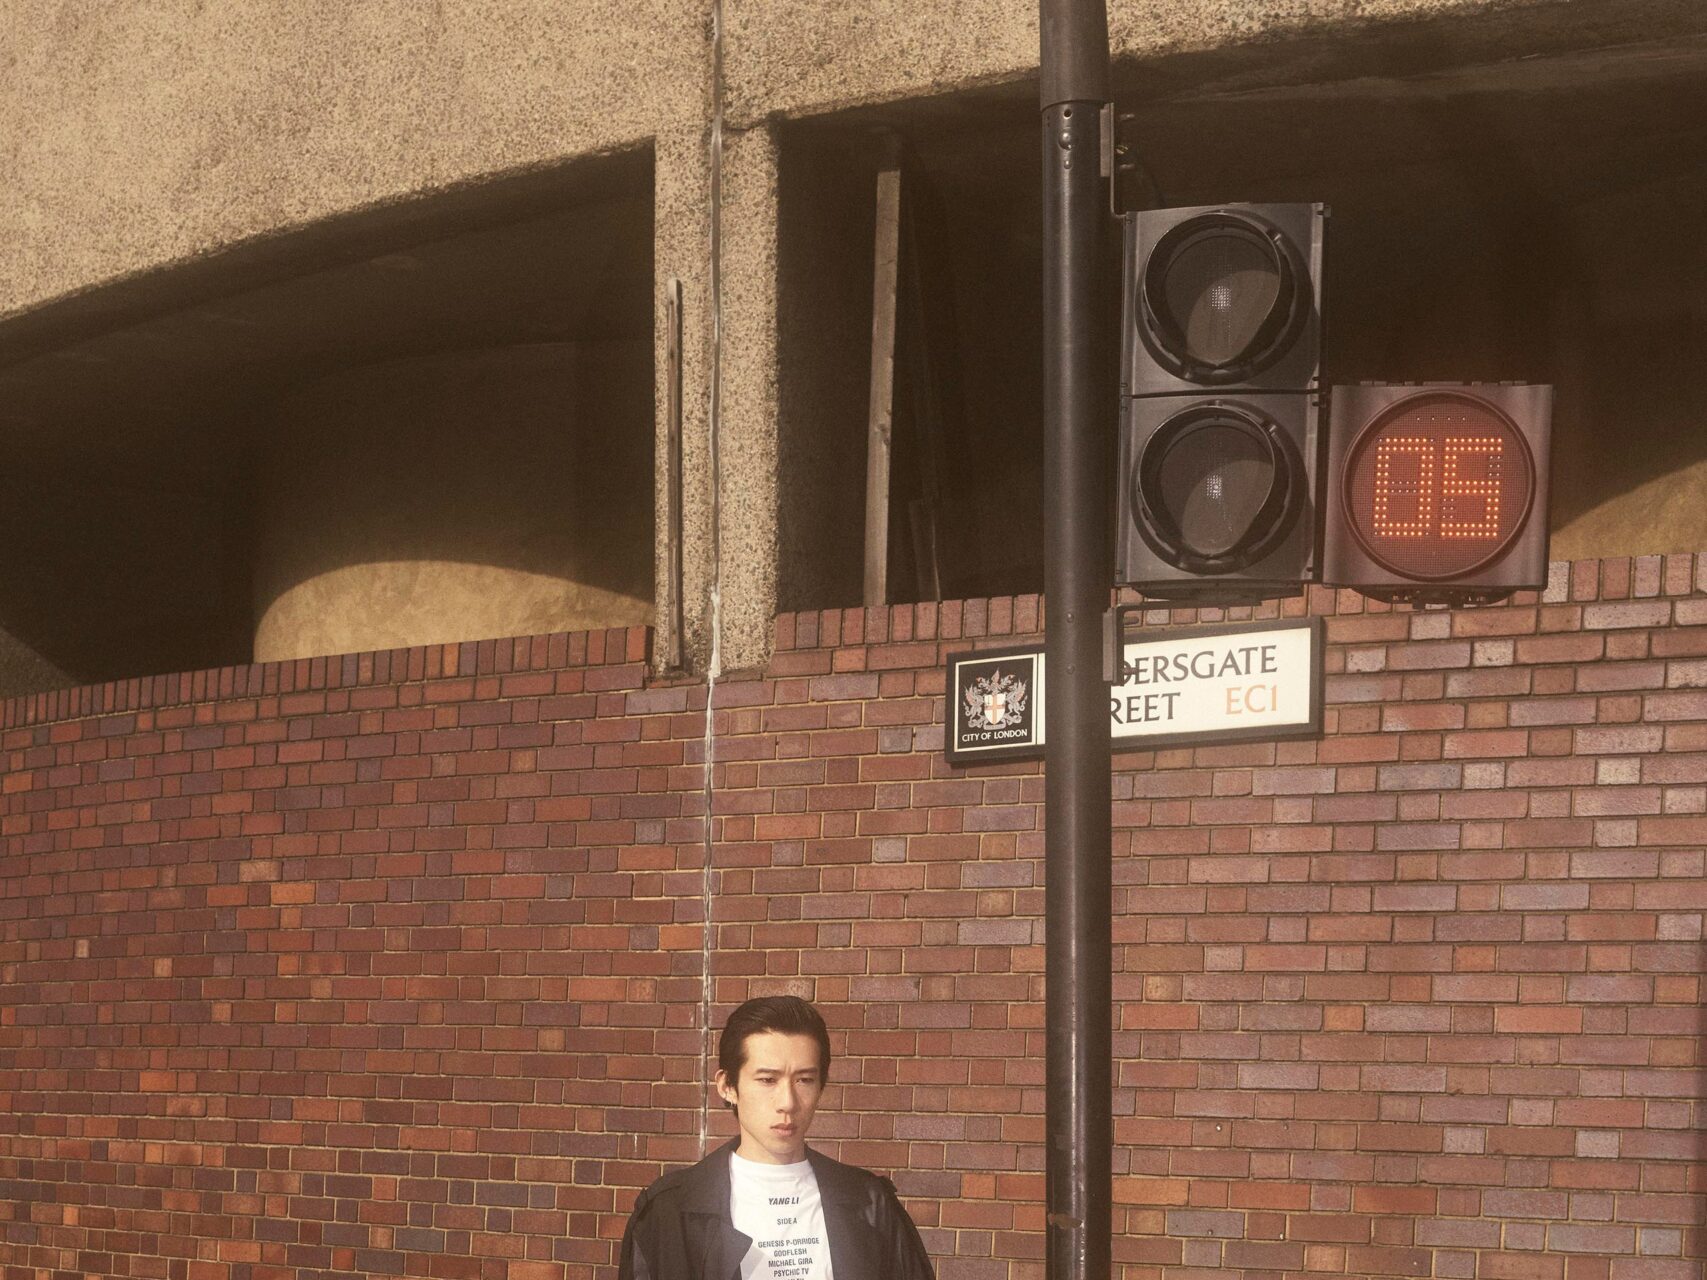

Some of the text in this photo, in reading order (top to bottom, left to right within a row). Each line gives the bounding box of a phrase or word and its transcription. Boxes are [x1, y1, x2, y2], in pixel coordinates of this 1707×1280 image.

[1373, 435, 1504, 538] 05
[962, 729, 1027, 742] CITY OF LONDON
[769, 1198, 790, 1206] YANG
[774, 1249, 807, 1257] GODFLESH
[768, 1259, 796, 1267] MICHAEL
[774, 1269, 799, 1277] PSYCHIC
